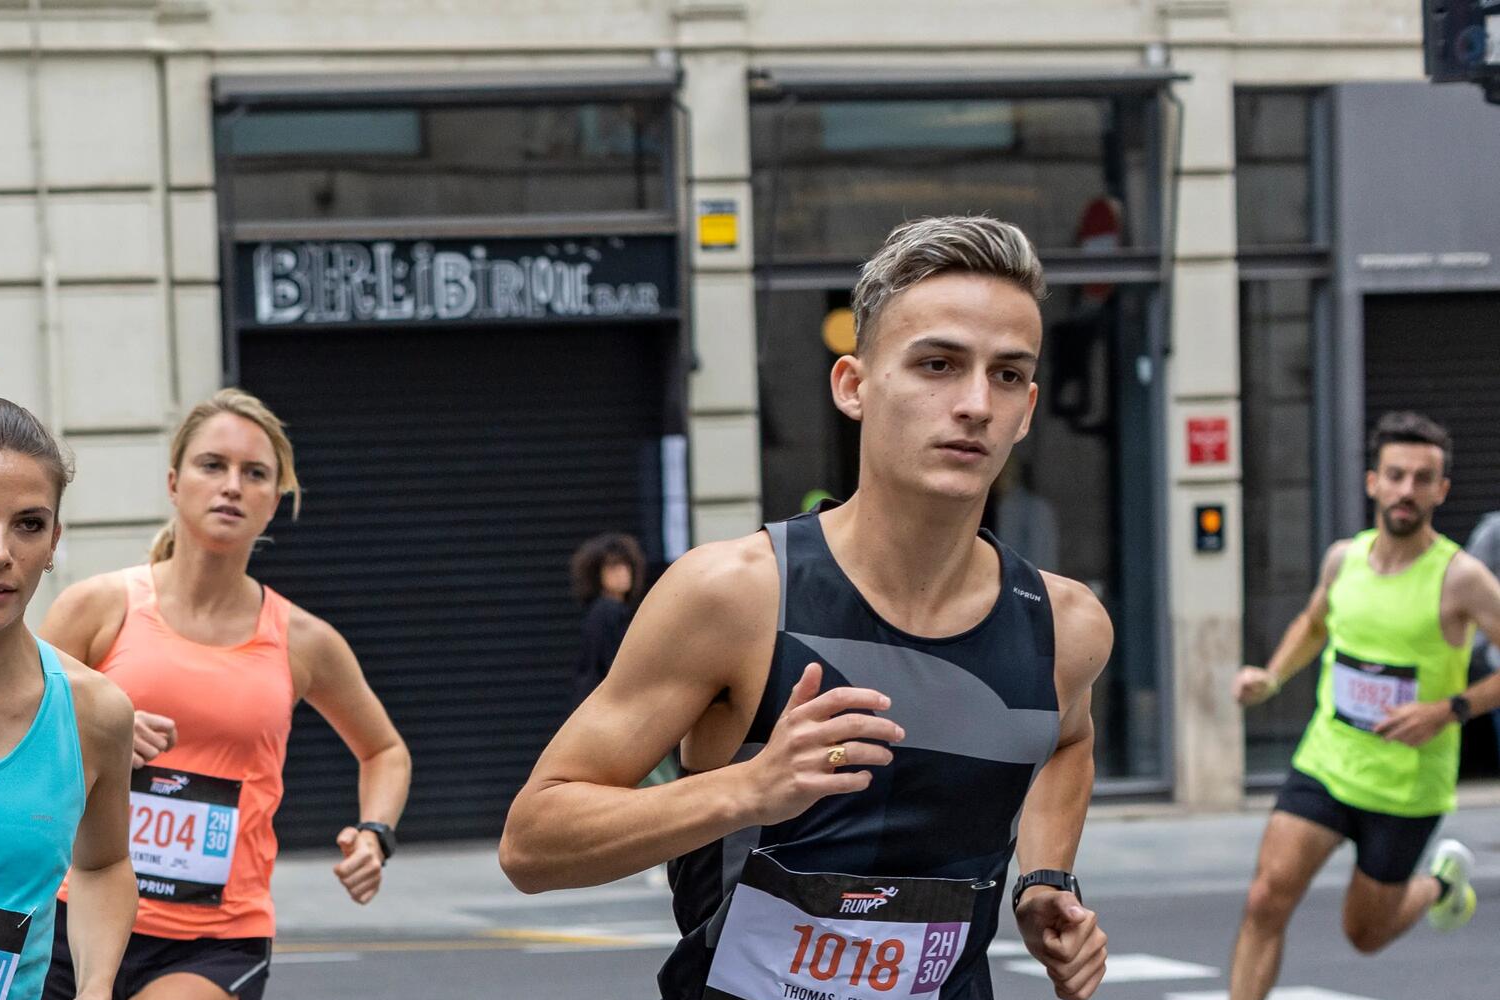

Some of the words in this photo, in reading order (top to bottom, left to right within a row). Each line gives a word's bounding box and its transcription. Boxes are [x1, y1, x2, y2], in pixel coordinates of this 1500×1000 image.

[1013, 586, 1041, 602] KIPRUN
[208, 811, 230, 831] 2H
[206, 831, 227, 851] 30
[839, 899, 872, 914] RUN
[925, 931, 955, 957] 2H
[789, 924, 905, 992] 1018
[918, 958, 947, 984] 30
